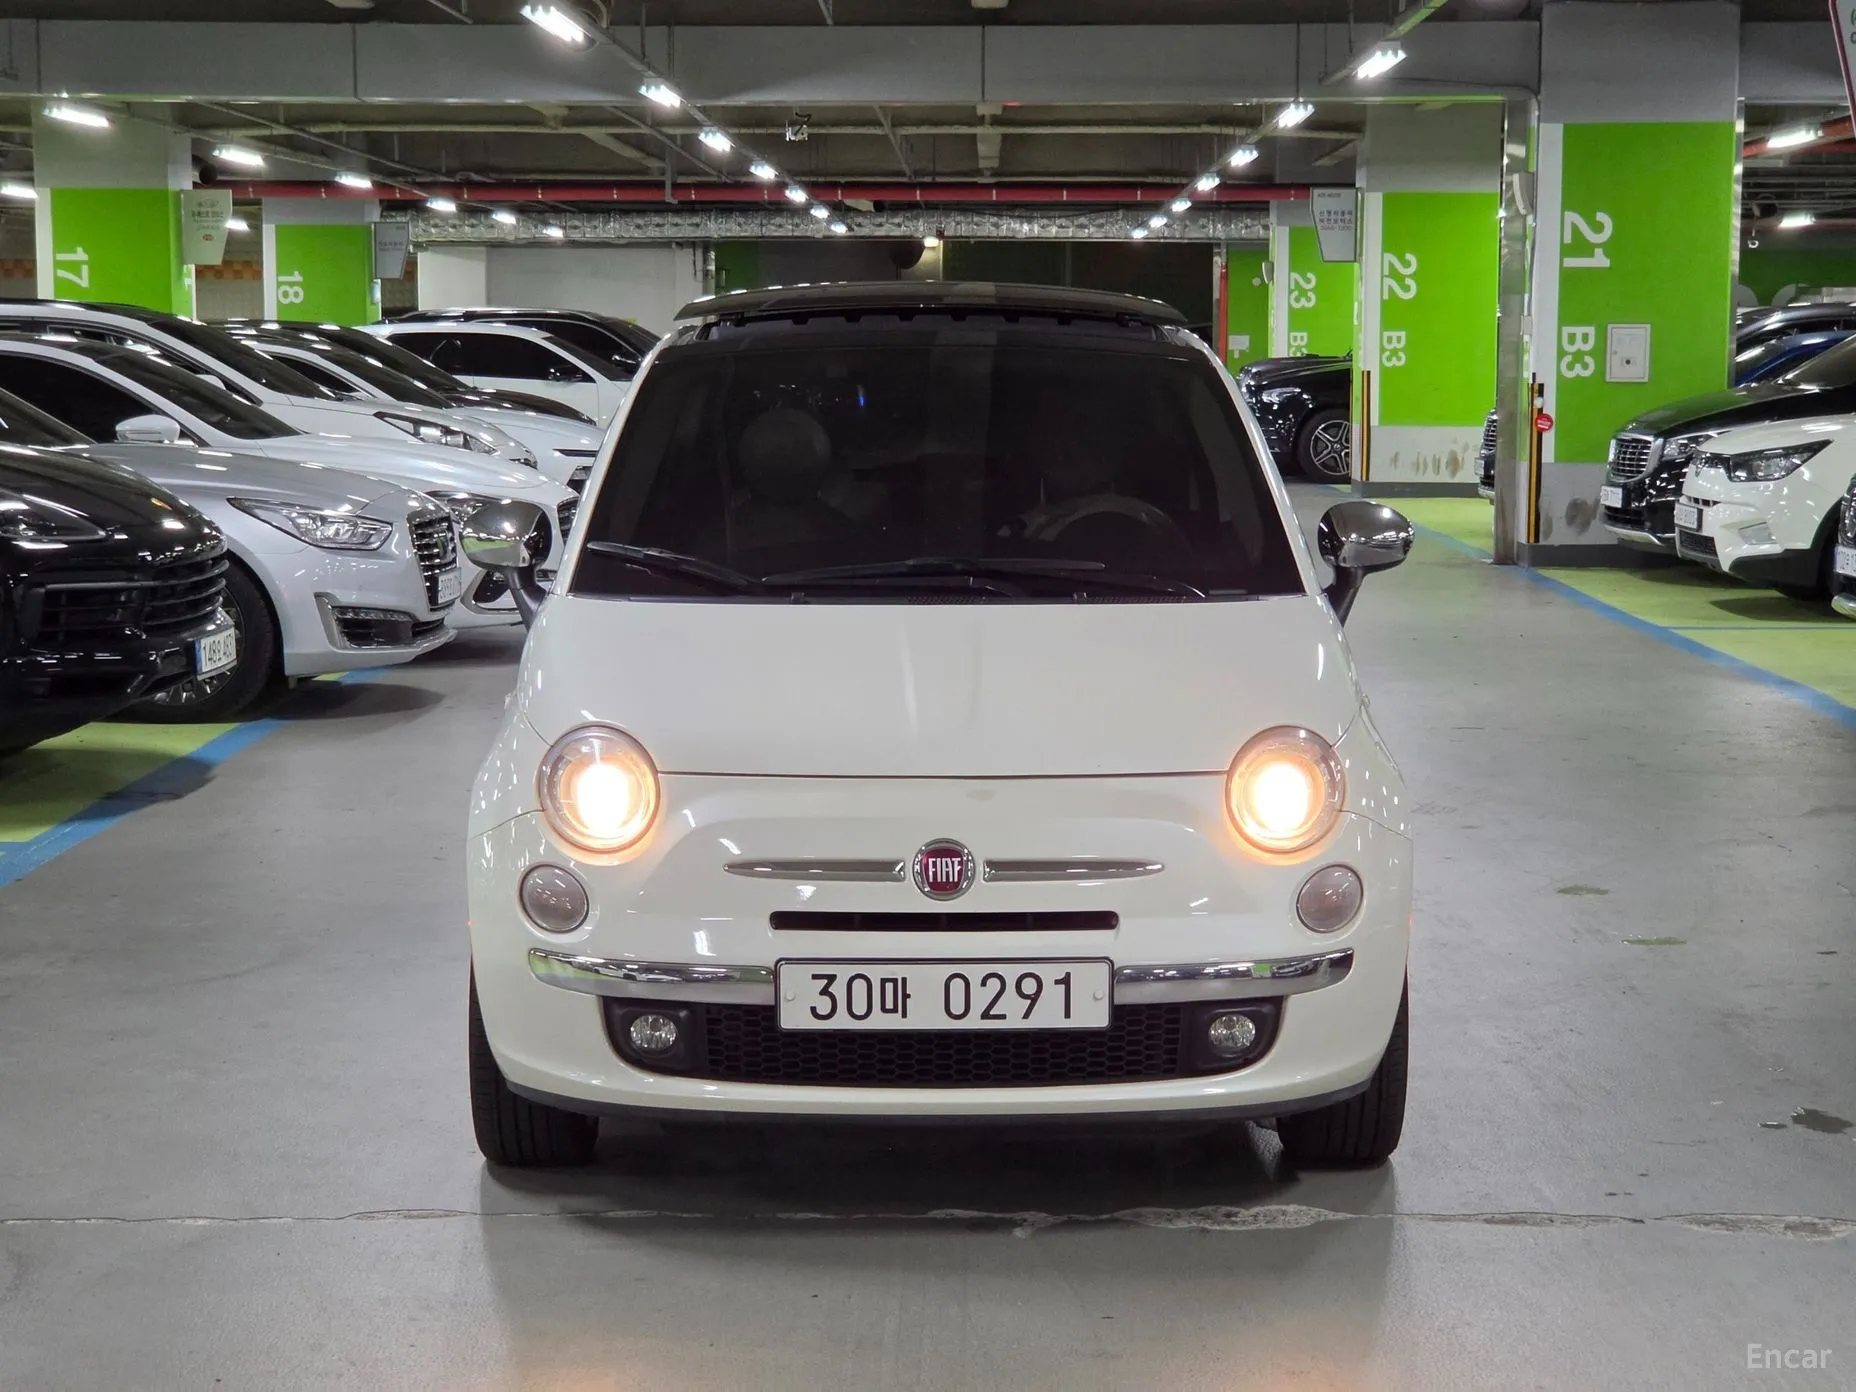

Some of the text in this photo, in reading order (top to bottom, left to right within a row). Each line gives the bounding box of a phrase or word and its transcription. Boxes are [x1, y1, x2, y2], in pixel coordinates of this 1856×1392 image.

[54, 246, 90, 289] 17
[276, 270, 305, 305] 18
[1289, 271, 1317, 309] 23
[1381, 252, 1418, 368] 22 B3
[1560, 210, 1613, 379] 21 B3
[928, 857, 962, 883] FIAT
[810, 971, 1072, 1021] 30마 0291
